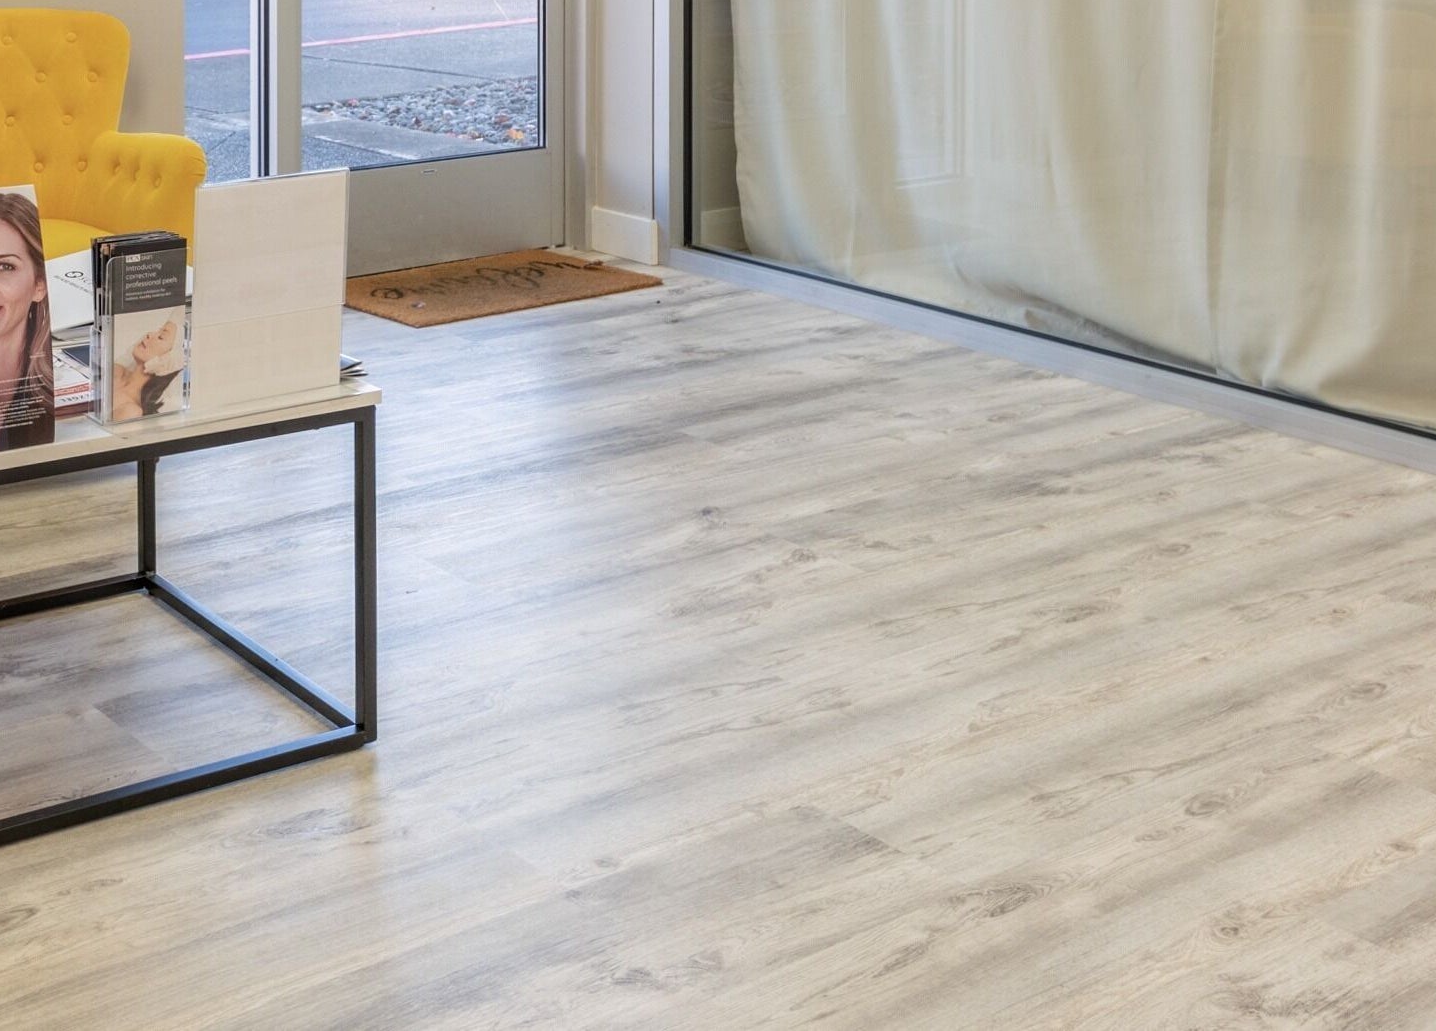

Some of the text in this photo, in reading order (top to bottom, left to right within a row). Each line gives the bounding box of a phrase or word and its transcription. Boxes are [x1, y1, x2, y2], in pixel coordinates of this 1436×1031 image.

[126, 263, 162, 271] Introducing
[125, 272, 157, 280] corrective
[125, 276, 178, 289] professional peels
